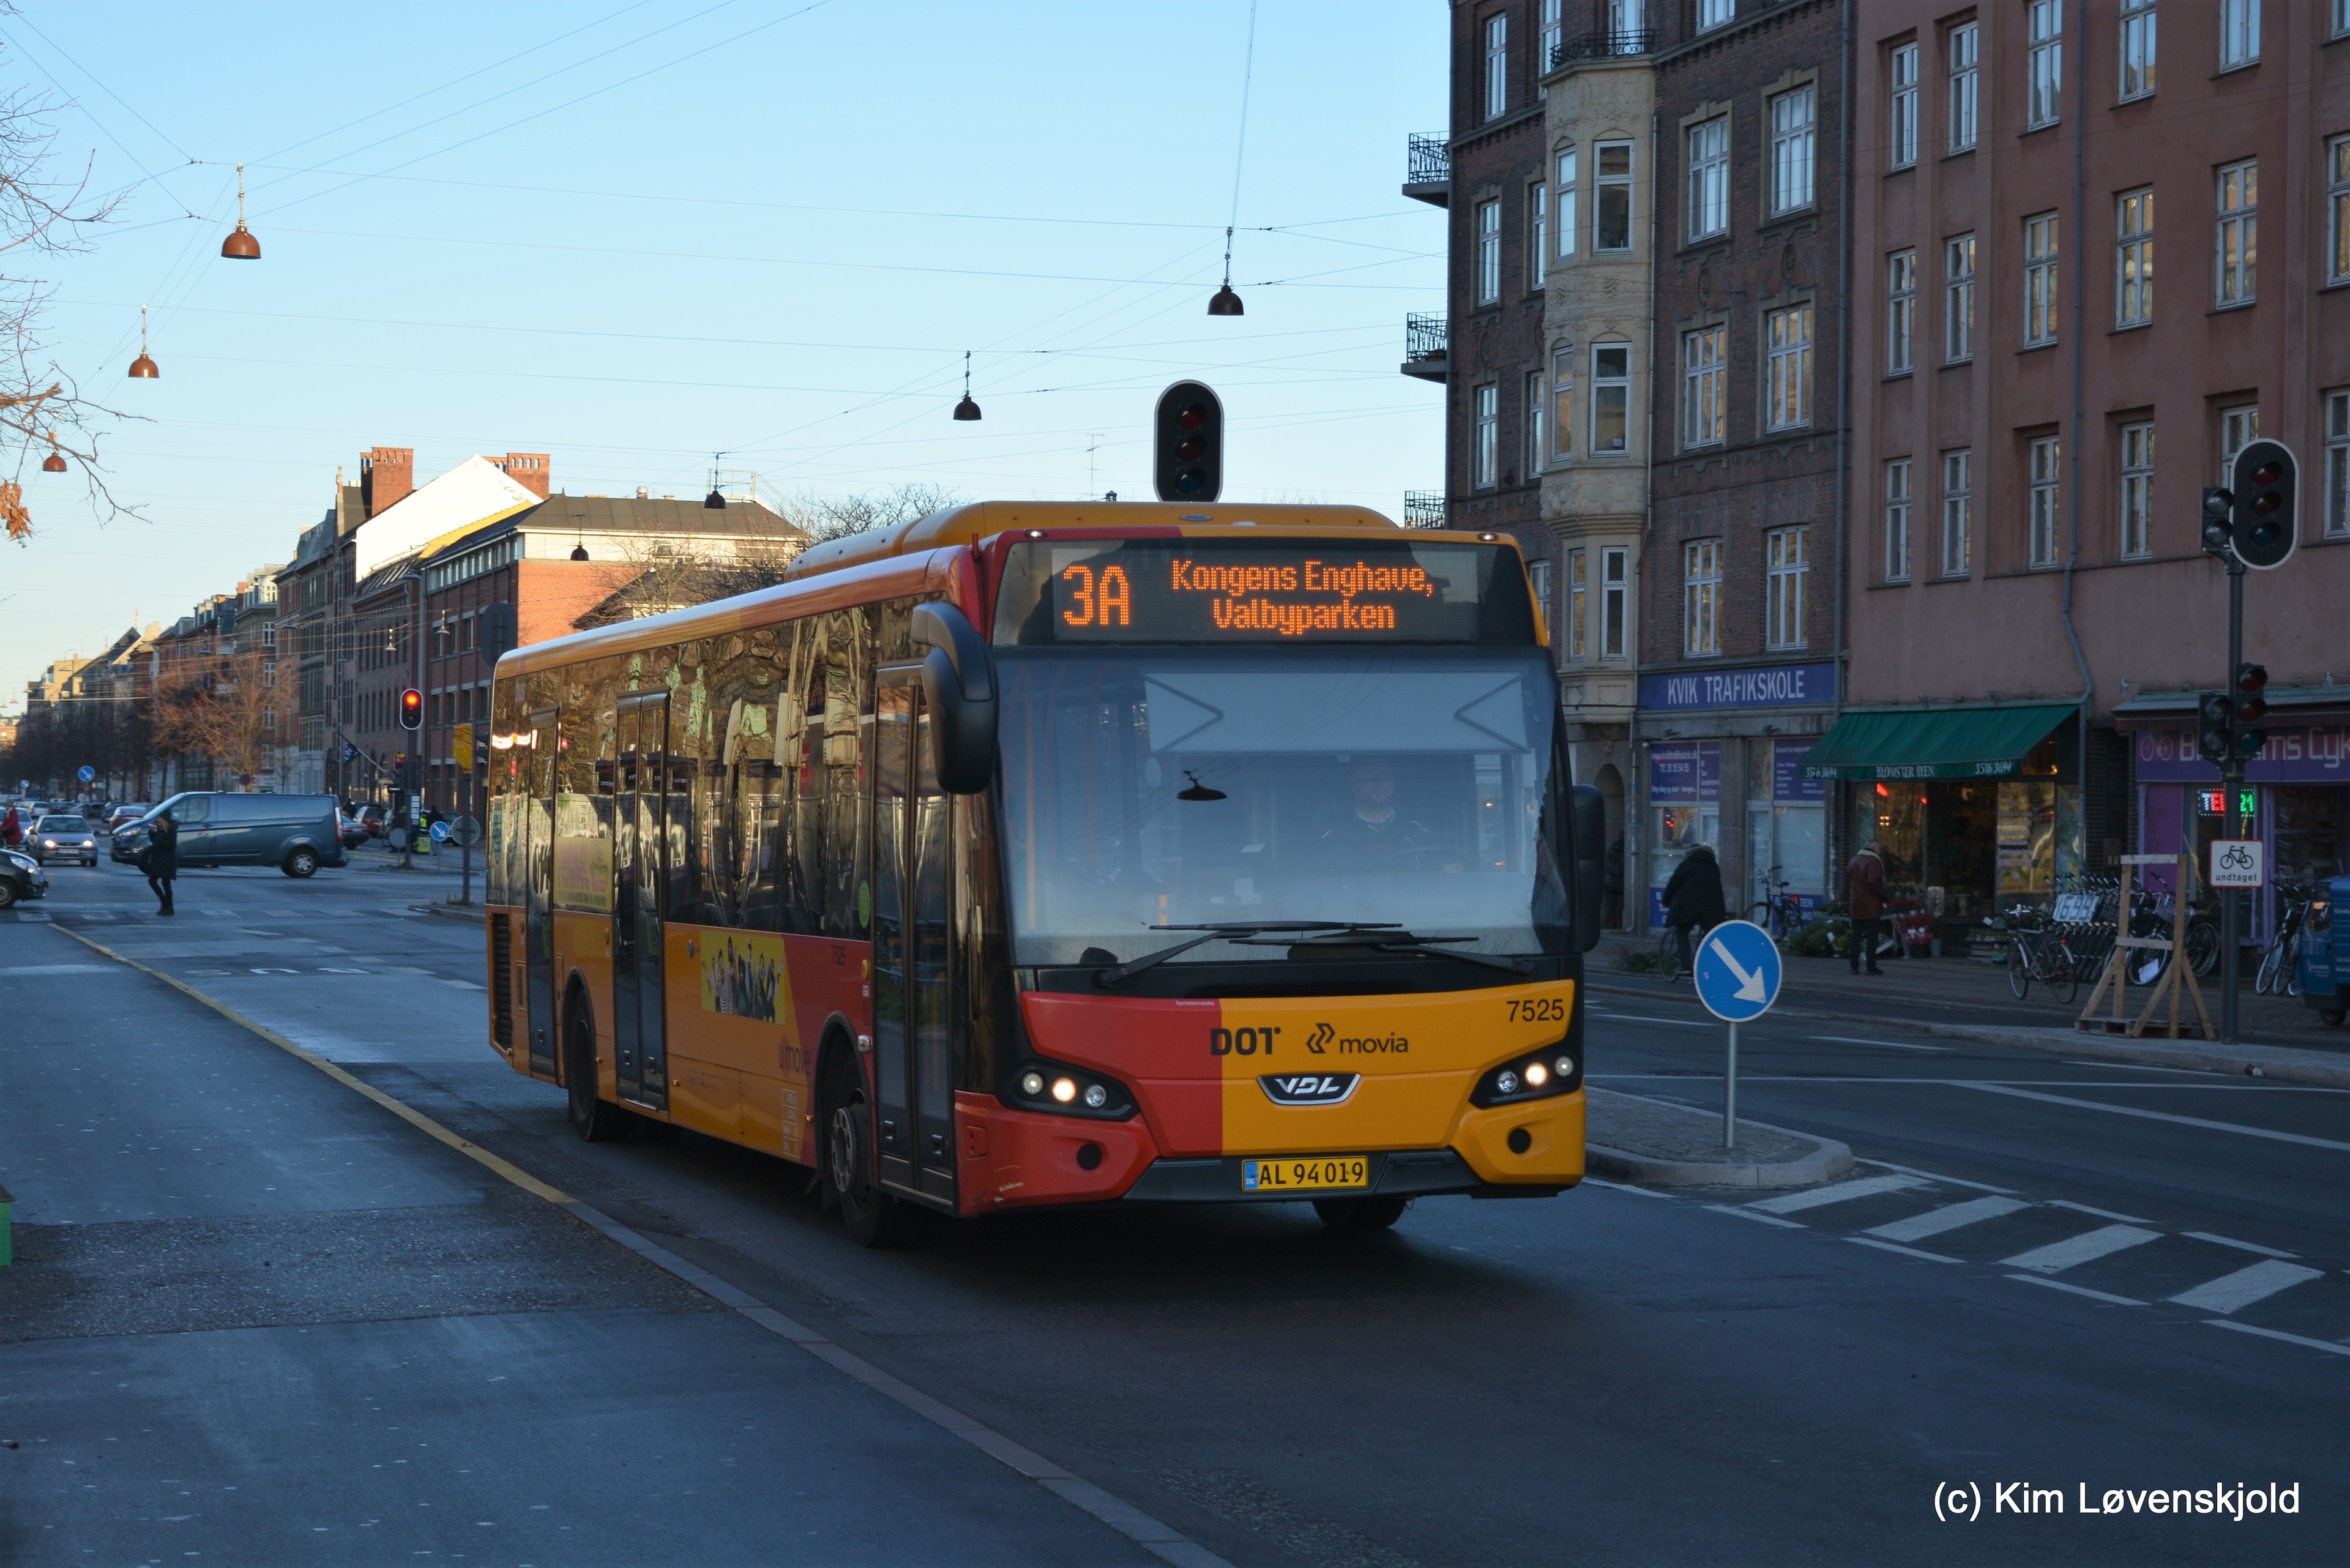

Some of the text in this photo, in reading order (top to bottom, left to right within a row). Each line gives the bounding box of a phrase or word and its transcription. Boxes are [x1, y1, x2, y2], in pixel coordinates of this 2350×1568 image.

[1172, 560, 1434, 598] Kongens Enghave,
[1063, 566, 1130, 625] 3A
[1213, 599, 1395, 635] Valbyparken
[1668, 670, 1805, 704] KVIK TRAFIKSKOLE
[1876, 764, 1934, 778] BLOMSTER BYEN
[2215, 873, 2257, 883] undtaget
[831, 945, 845, 966] 7525
[1506, 999, 1564, 1022] 7525
[1210, 1027, 1281, 1055] DOT
[1339, 1032, 1408, 1053] movia
[1275, 1077, 1340, 1094] VDL
[1259, 1164, 1286, 1185] AL
